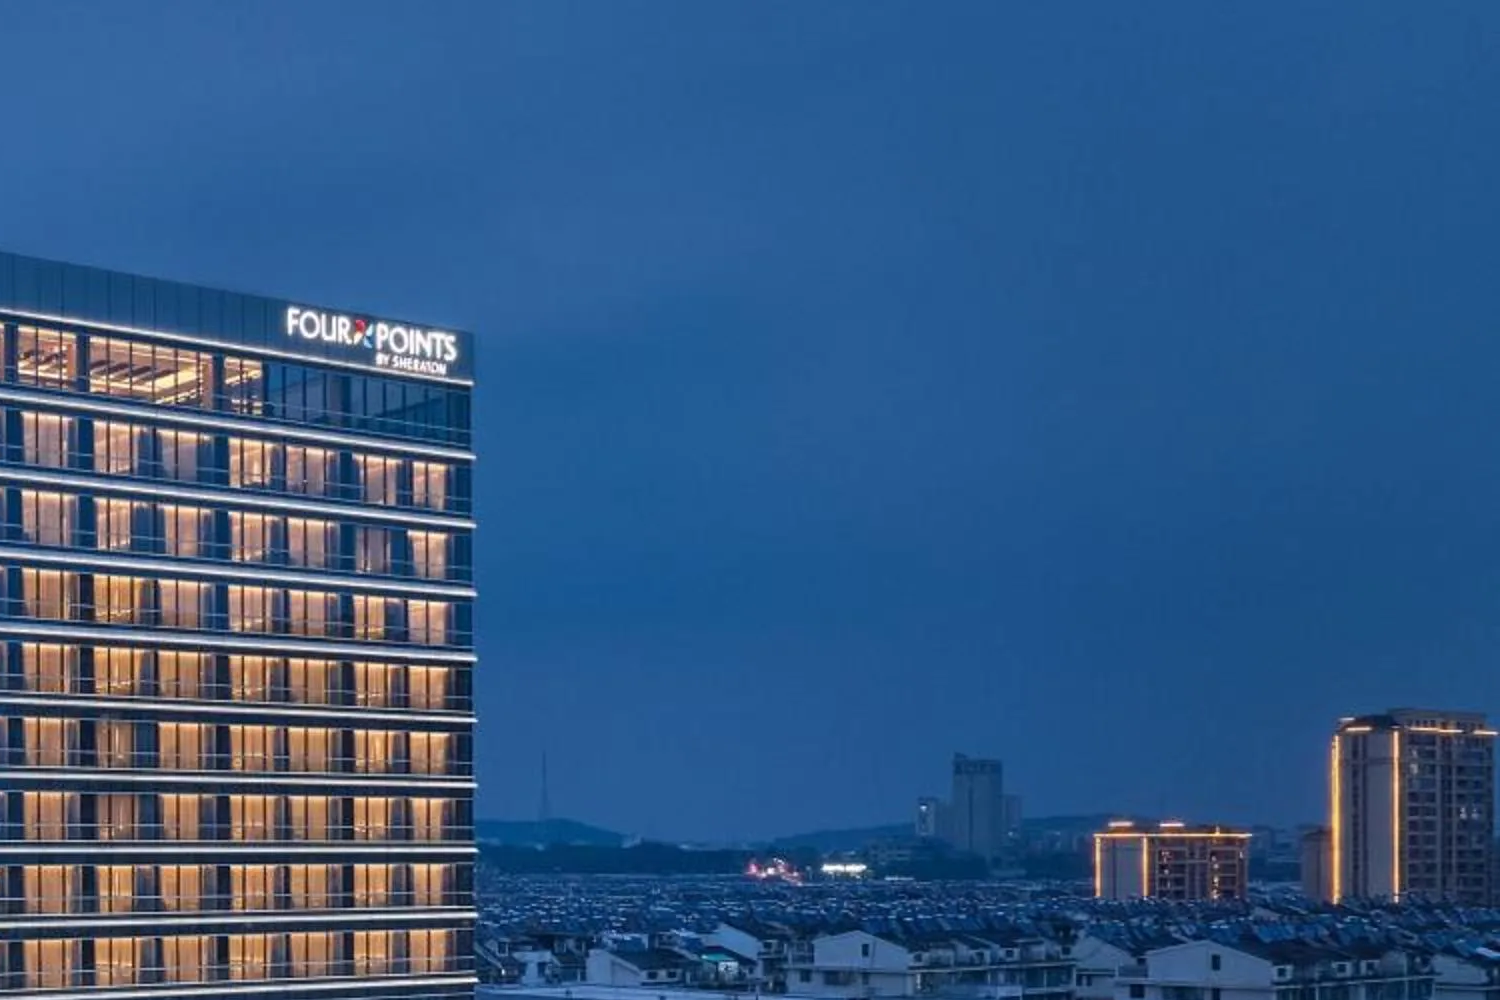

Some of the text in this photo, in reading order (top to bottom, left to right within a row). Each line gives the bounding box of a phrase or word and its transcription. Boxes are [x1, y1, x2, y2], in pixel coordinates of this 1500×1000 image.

[286, 306, 457, 361] FOUR POINTS
[376, 353, 447, 375] BY SHERATON
